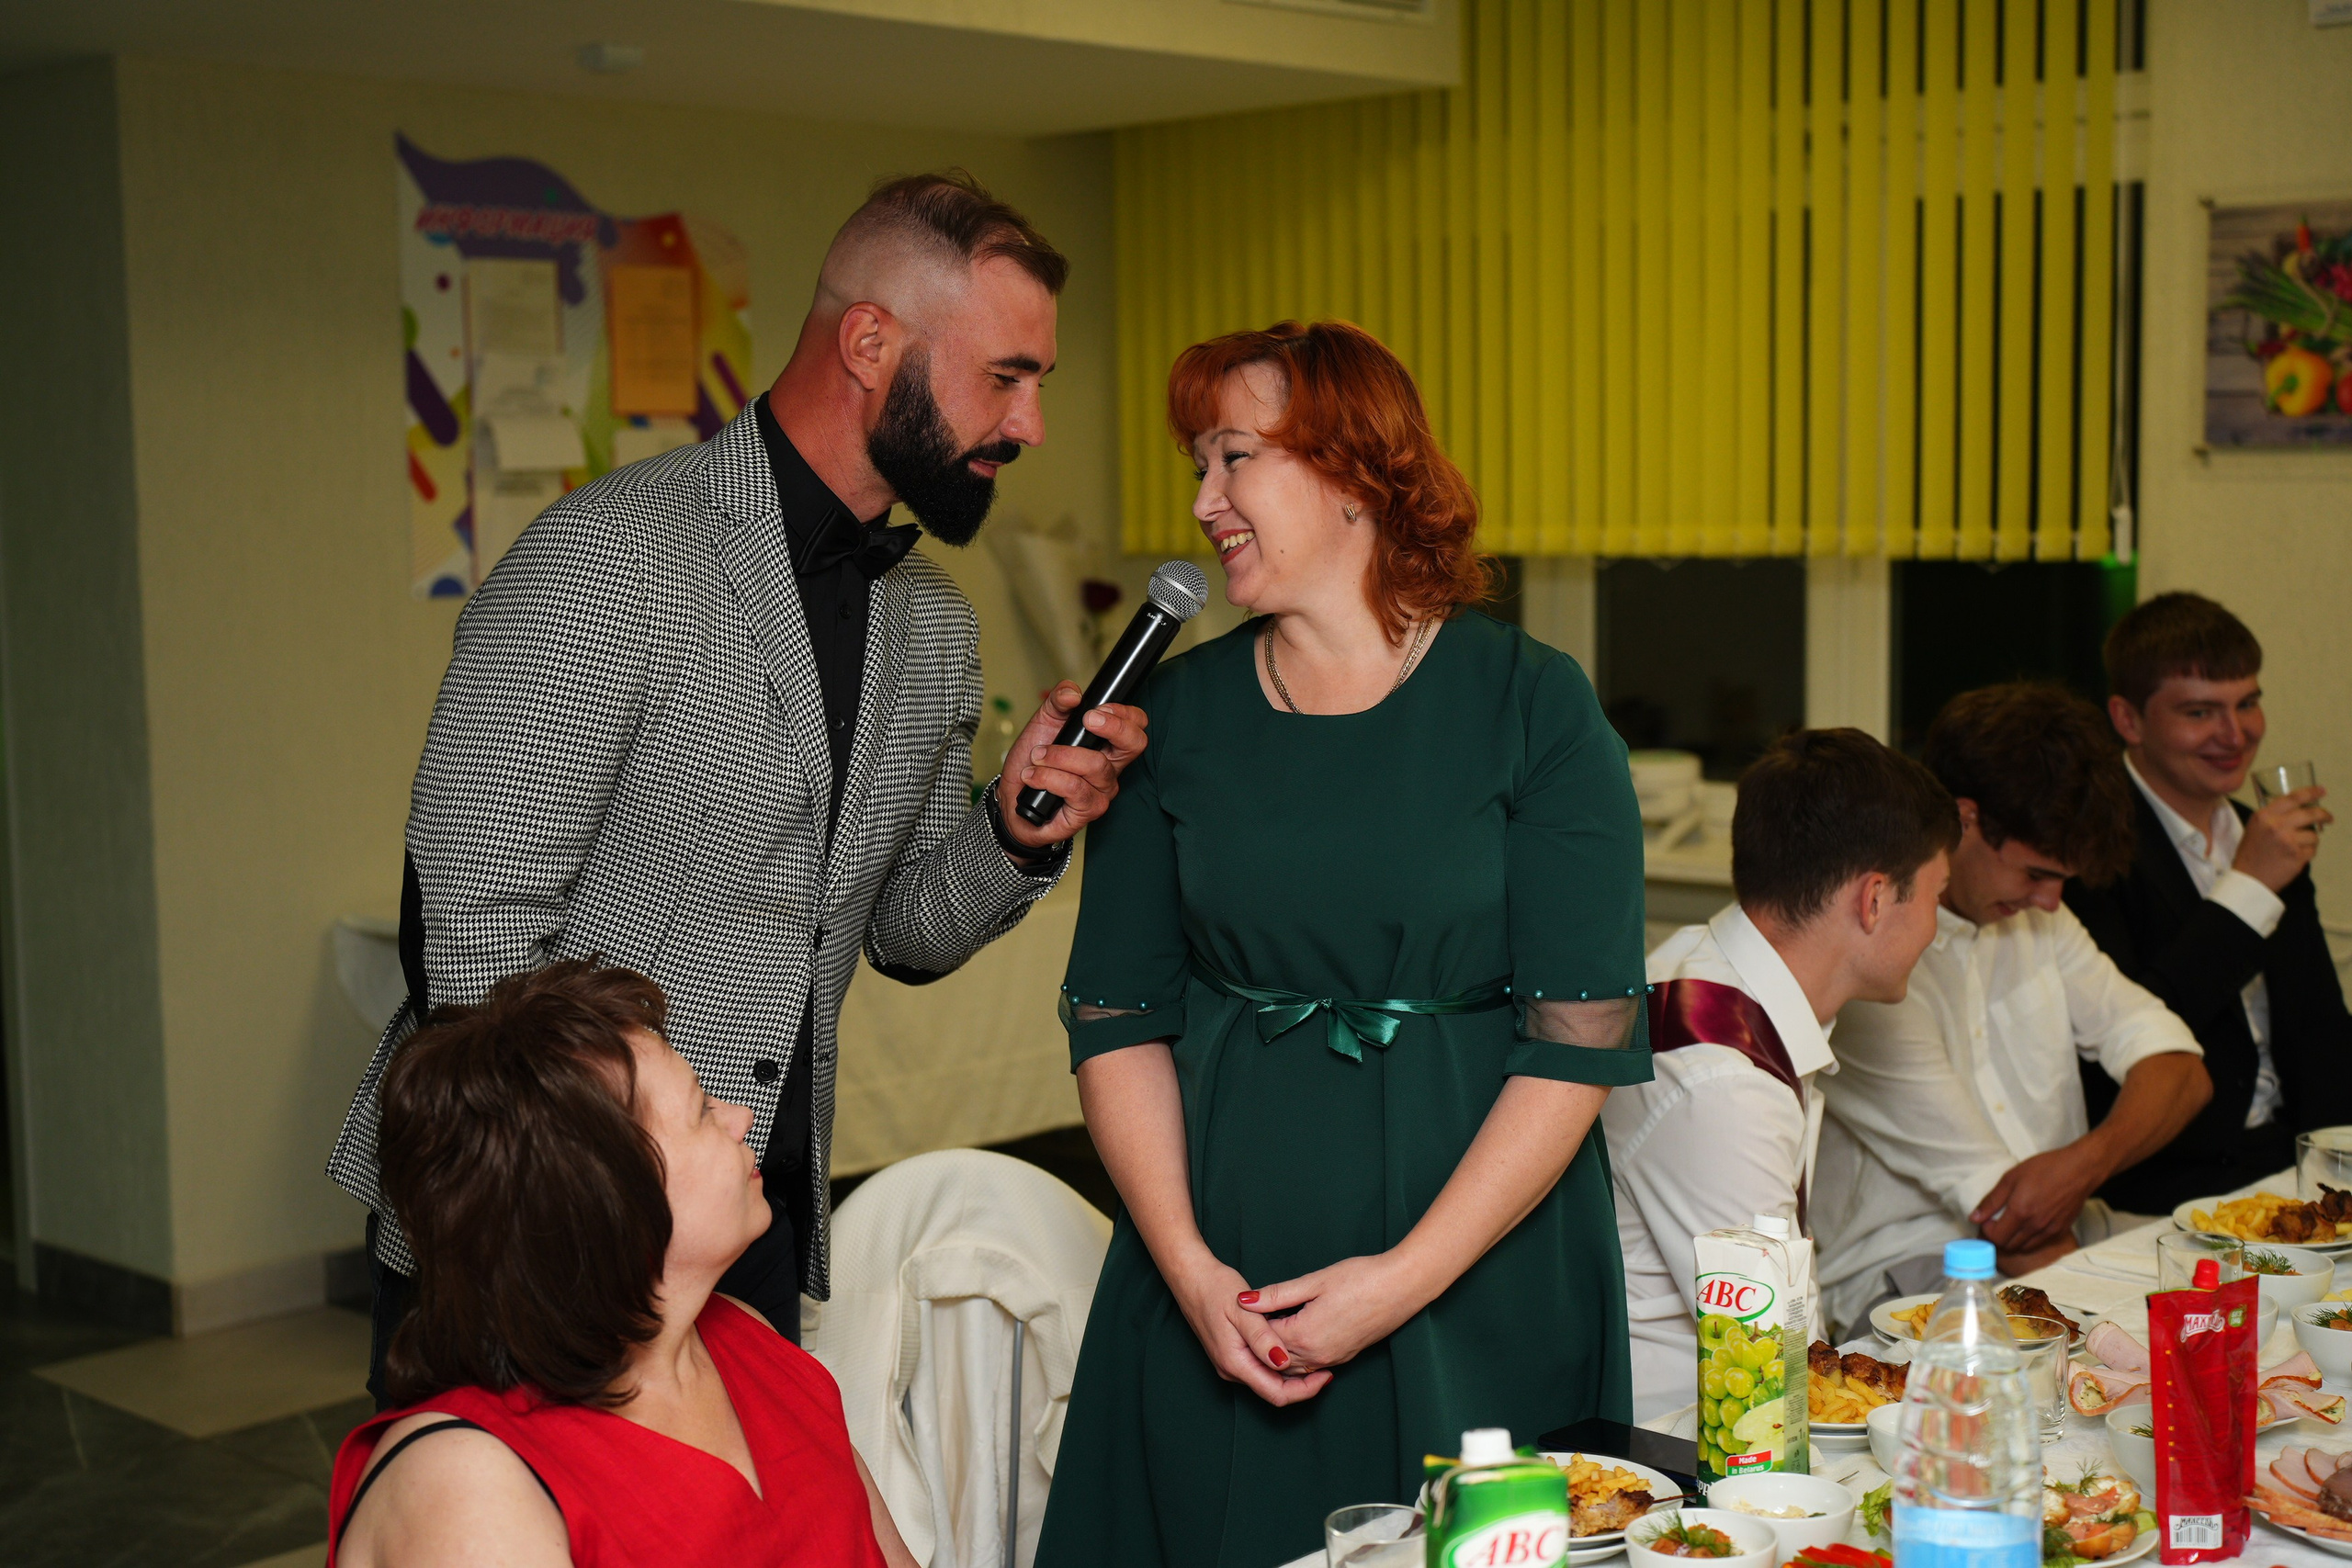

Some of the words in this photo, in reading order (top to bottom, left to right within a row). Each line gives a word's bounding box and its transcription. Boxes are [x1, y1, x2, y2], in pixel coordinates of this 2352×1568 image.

[1696, 1279, 1757, 1312] ABC
[1738, 1456, 1757, 1464] Made
[1738, 1464, 1765, 1474] Belarus
[1466, 1525, 1564, 1567] ABC
